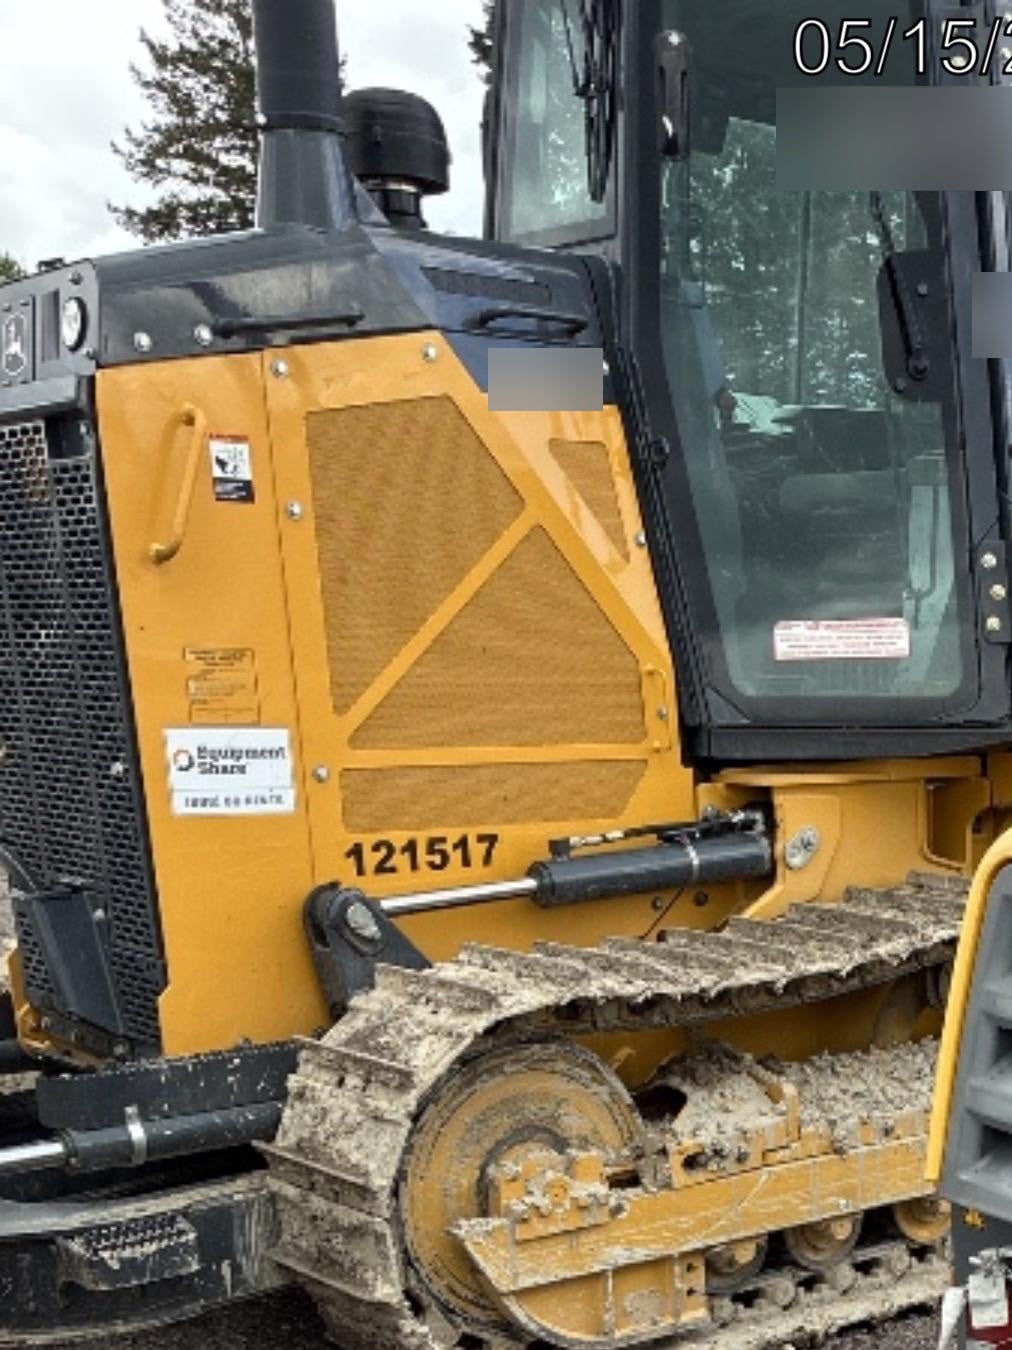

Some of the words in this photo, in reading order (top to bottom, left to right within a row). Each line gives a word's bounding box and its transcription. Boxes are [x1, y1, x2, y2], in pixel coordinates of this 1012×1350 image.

[196, 746, 286, 762] Equipment
[197, 761, 248, 775] Share
[345, 833, 498, 877] 121517
